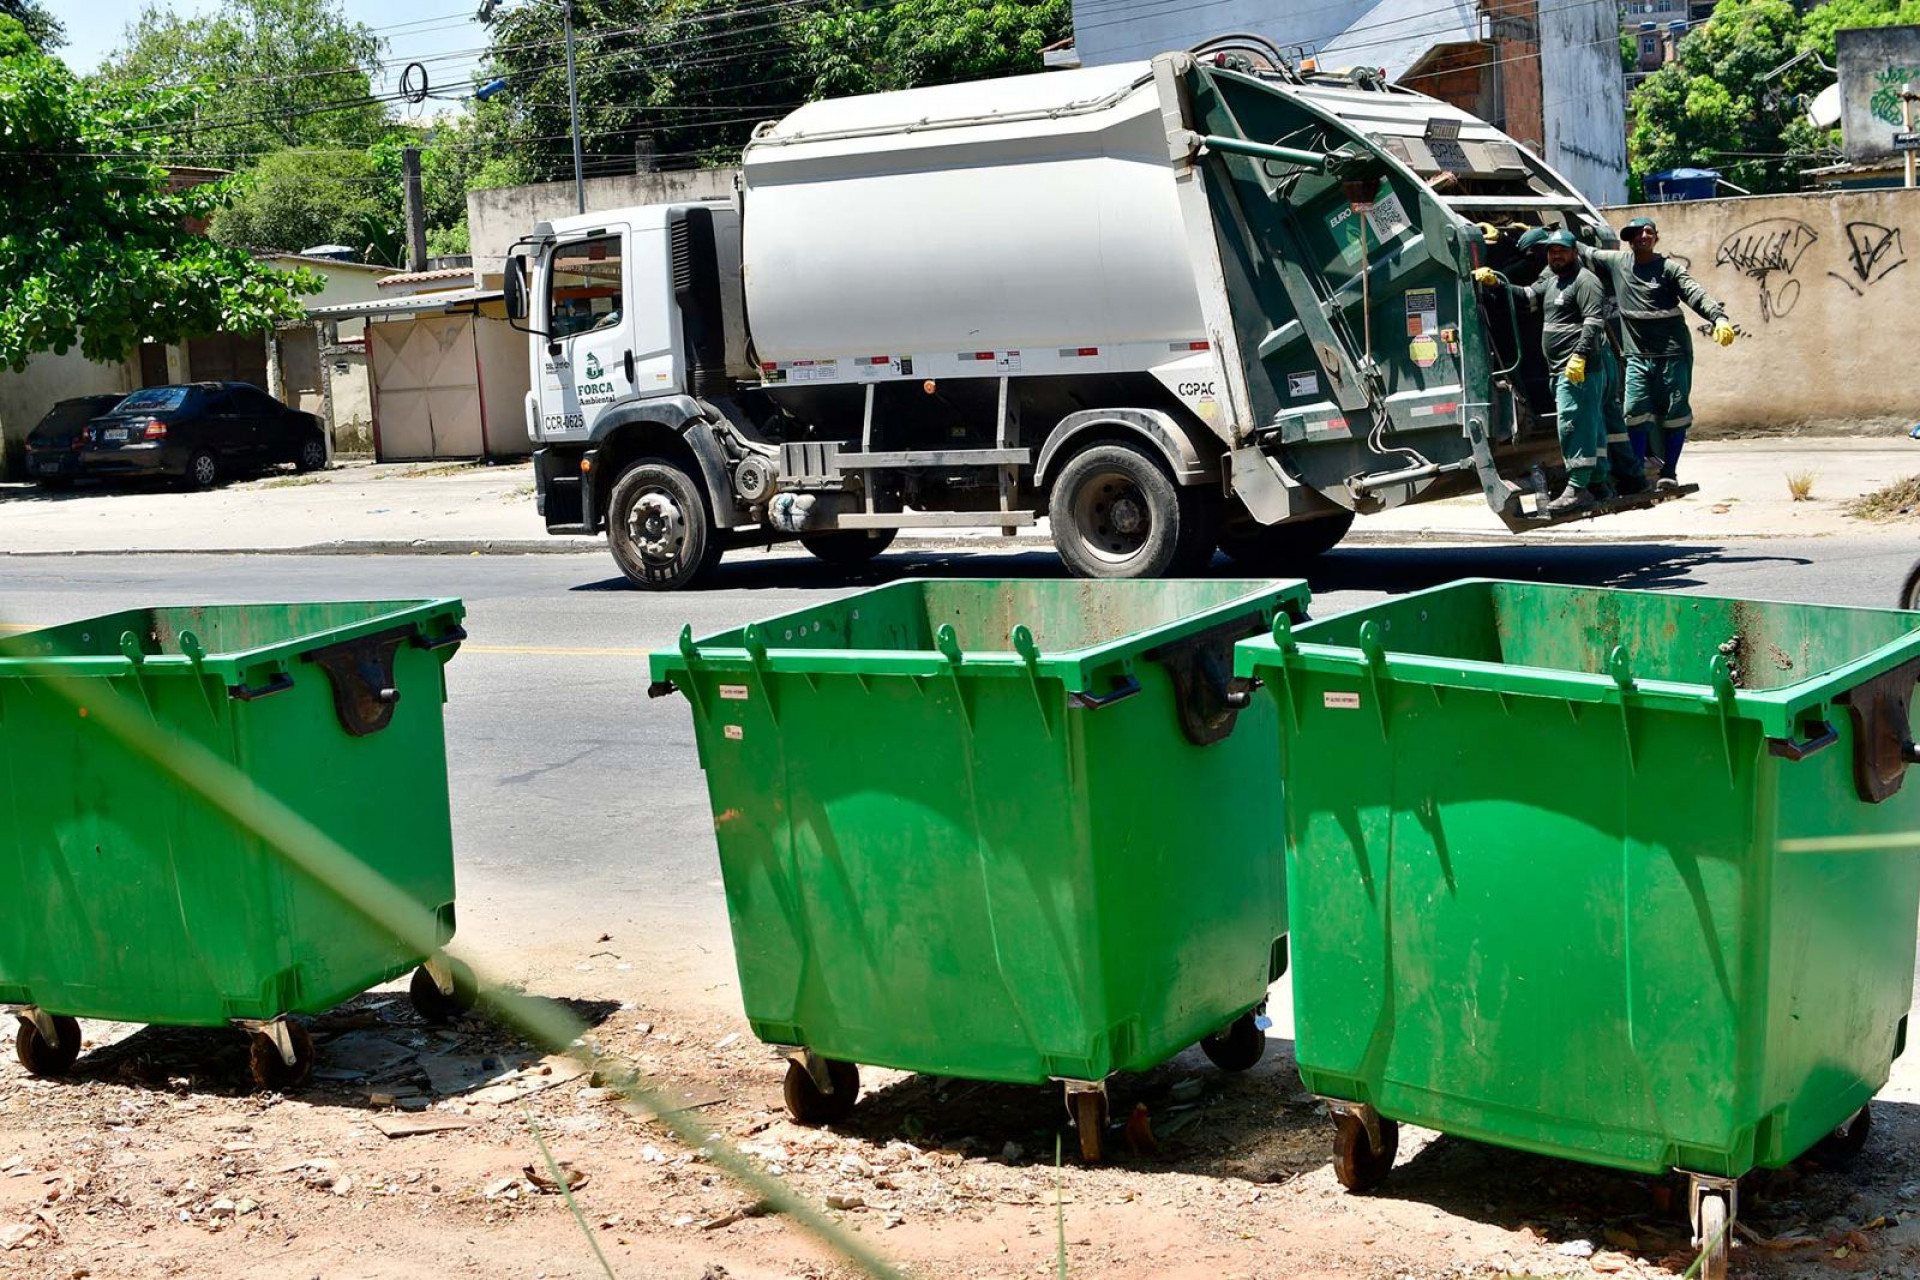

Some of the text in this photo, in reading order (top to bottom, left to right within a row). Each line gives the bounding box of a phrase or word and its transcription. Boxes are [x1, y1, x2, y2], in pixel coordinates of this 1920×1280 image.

[1330, 208, 1352, 228] EURO
[1178, 382, 1216, 396] COPAC
[579, 395, 616, 406] Ambiental
[545, 413, 584, 431] CCR-0625
